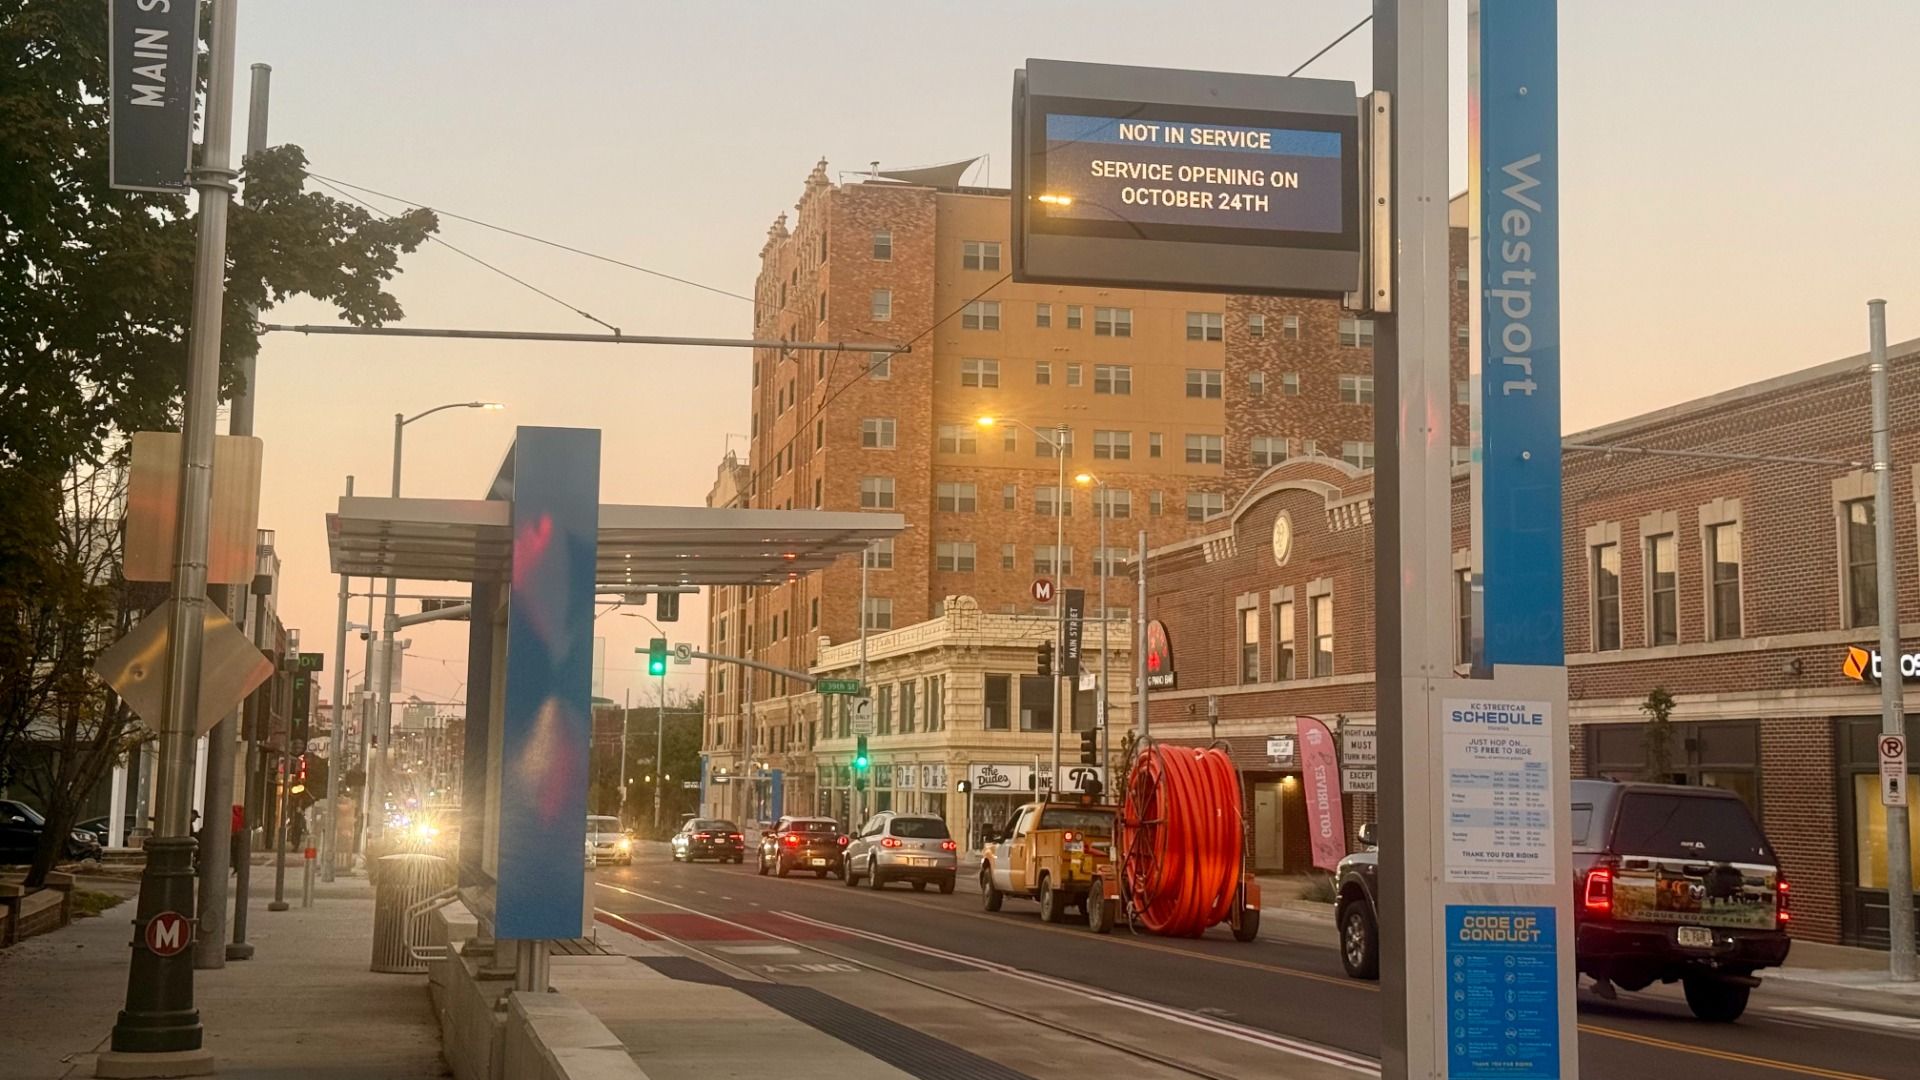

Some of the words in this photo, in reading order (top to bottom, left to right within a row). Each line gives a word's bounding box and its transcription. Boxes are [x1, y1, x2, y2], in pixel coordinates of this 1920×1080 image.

[130, 28, 169, 107] MAIN
[1119, 123, 1160, 143] NOT
[1165, 126, 1184, 144] IN
[1190, 128, 1271, 149] SERVICE
[1091, 160, 1173, 181] SERVICE
[1178, 165, 1265, 187] OPENING
[1270, 171, 1298, 189] ON
[1122, 187, 1213, 209] OCTOBER
[1218, 193, 1269, 212] 24TH
[1485, 153, 1542, 396] Westport
[1036, 582, 1050, 599] M
[1483, 703, 1526, 711] STREETCAR
[1452, 711, 1543, 725] SCHEDULE
[1351, 741, 1372, 749] MUST
[1469, 738, 1487, 746] JUST
[1490, 739, 1506, 747] HOP
[981, 764, 999, 776] The
[1350, 771, 1373, 779] EXCEPT
[976, 774, 1009, 785] Dudes
[1463, 916, 1510, 929] CODE
[1514, 917, 1537, 929] OF
[155, 919, 180, 949] M
[1459, 929, 1541, 942] CONDUCT
